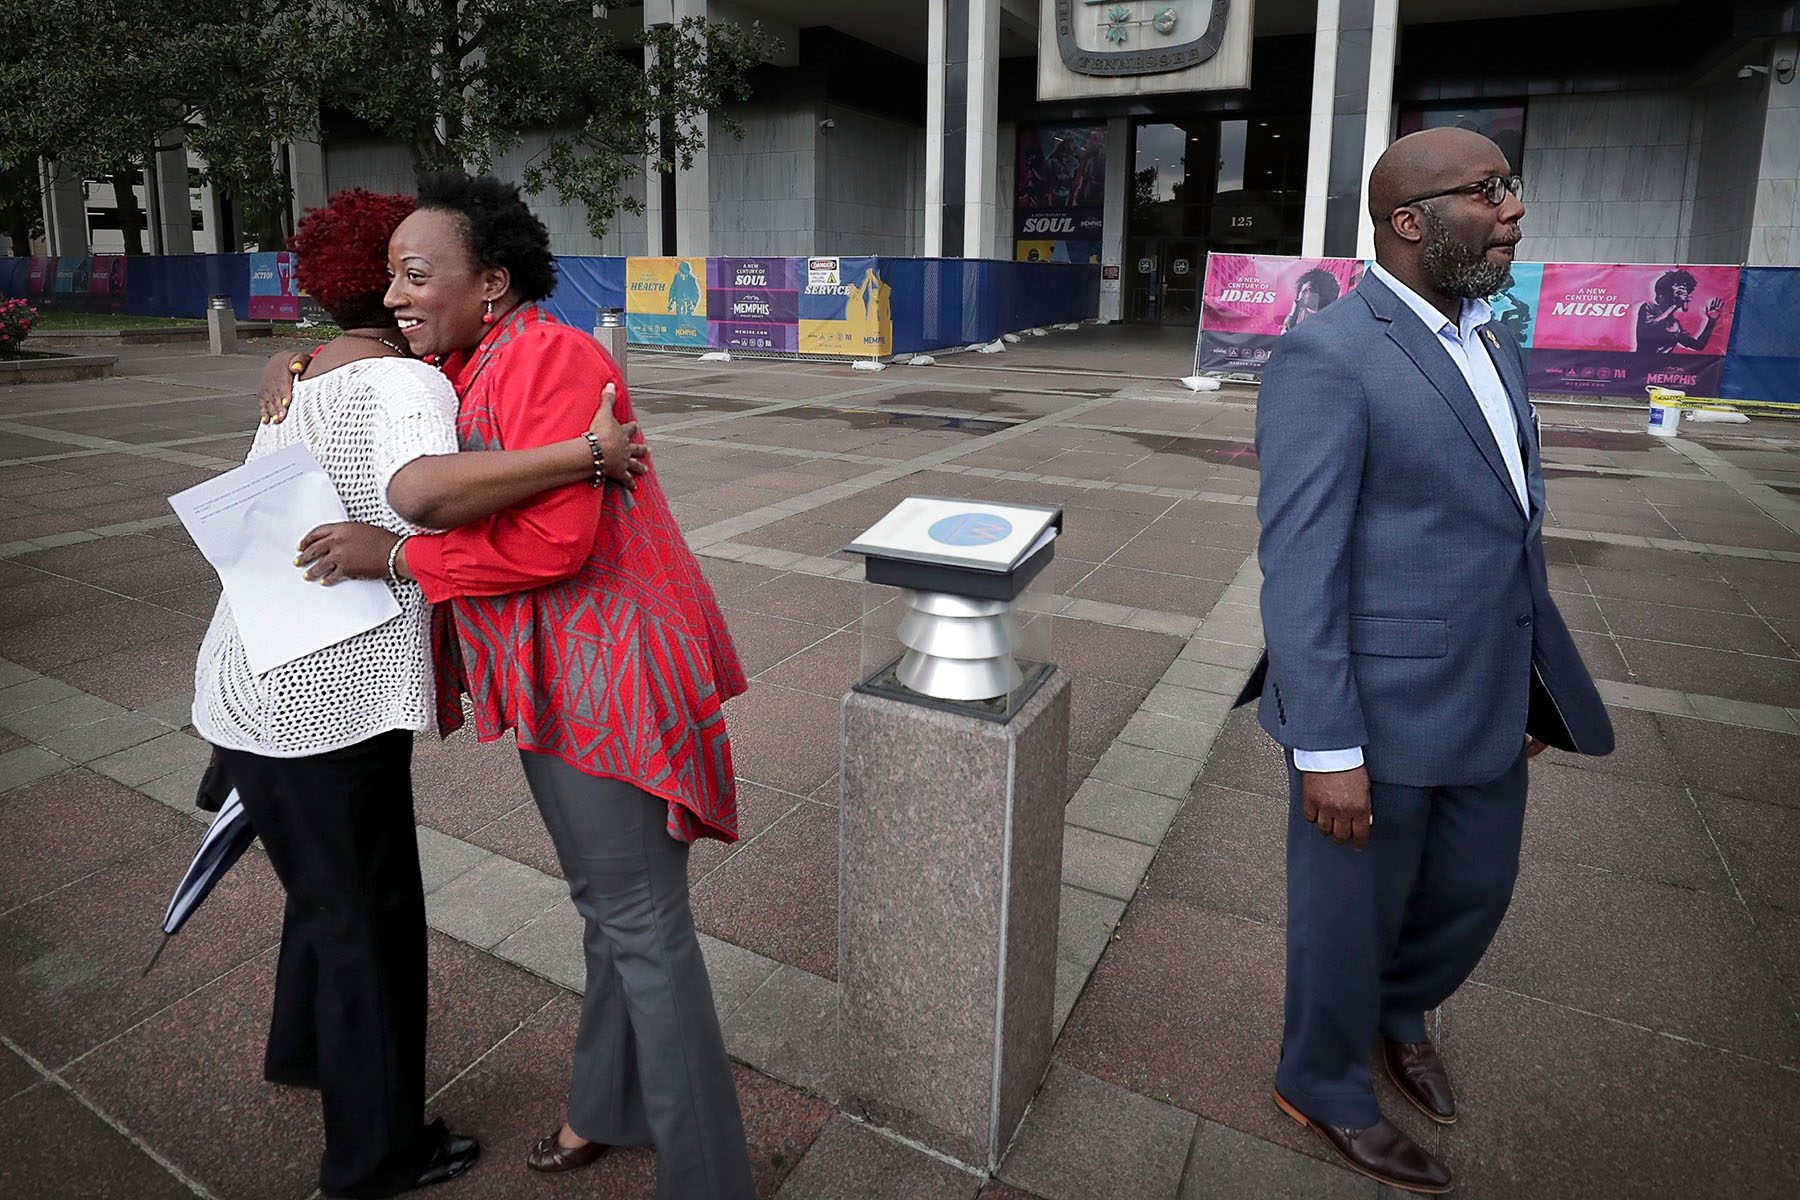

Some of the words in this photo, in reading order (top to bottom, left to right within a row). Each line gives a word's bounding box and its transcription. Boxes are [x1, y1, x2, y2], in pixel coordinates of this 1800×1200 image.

[1079, 49, 1201, 69] TENNESSEE
[1023, 217, 1076, 233] SOUL
[1231, 216, 1253, 227] 125
[630, 282, 666, 291] HEALTH
[734, 275, 767, 286] SOUL
[804, 285, 852, 296] SERVICE
[1219, 290, 1277, 303] IDEAS
[733, 303, 770, 316] MEMPHIS
[1551, 302, 1631, 317] MUSIC
[1646, 373, 1697, 386] MEMPHIS
